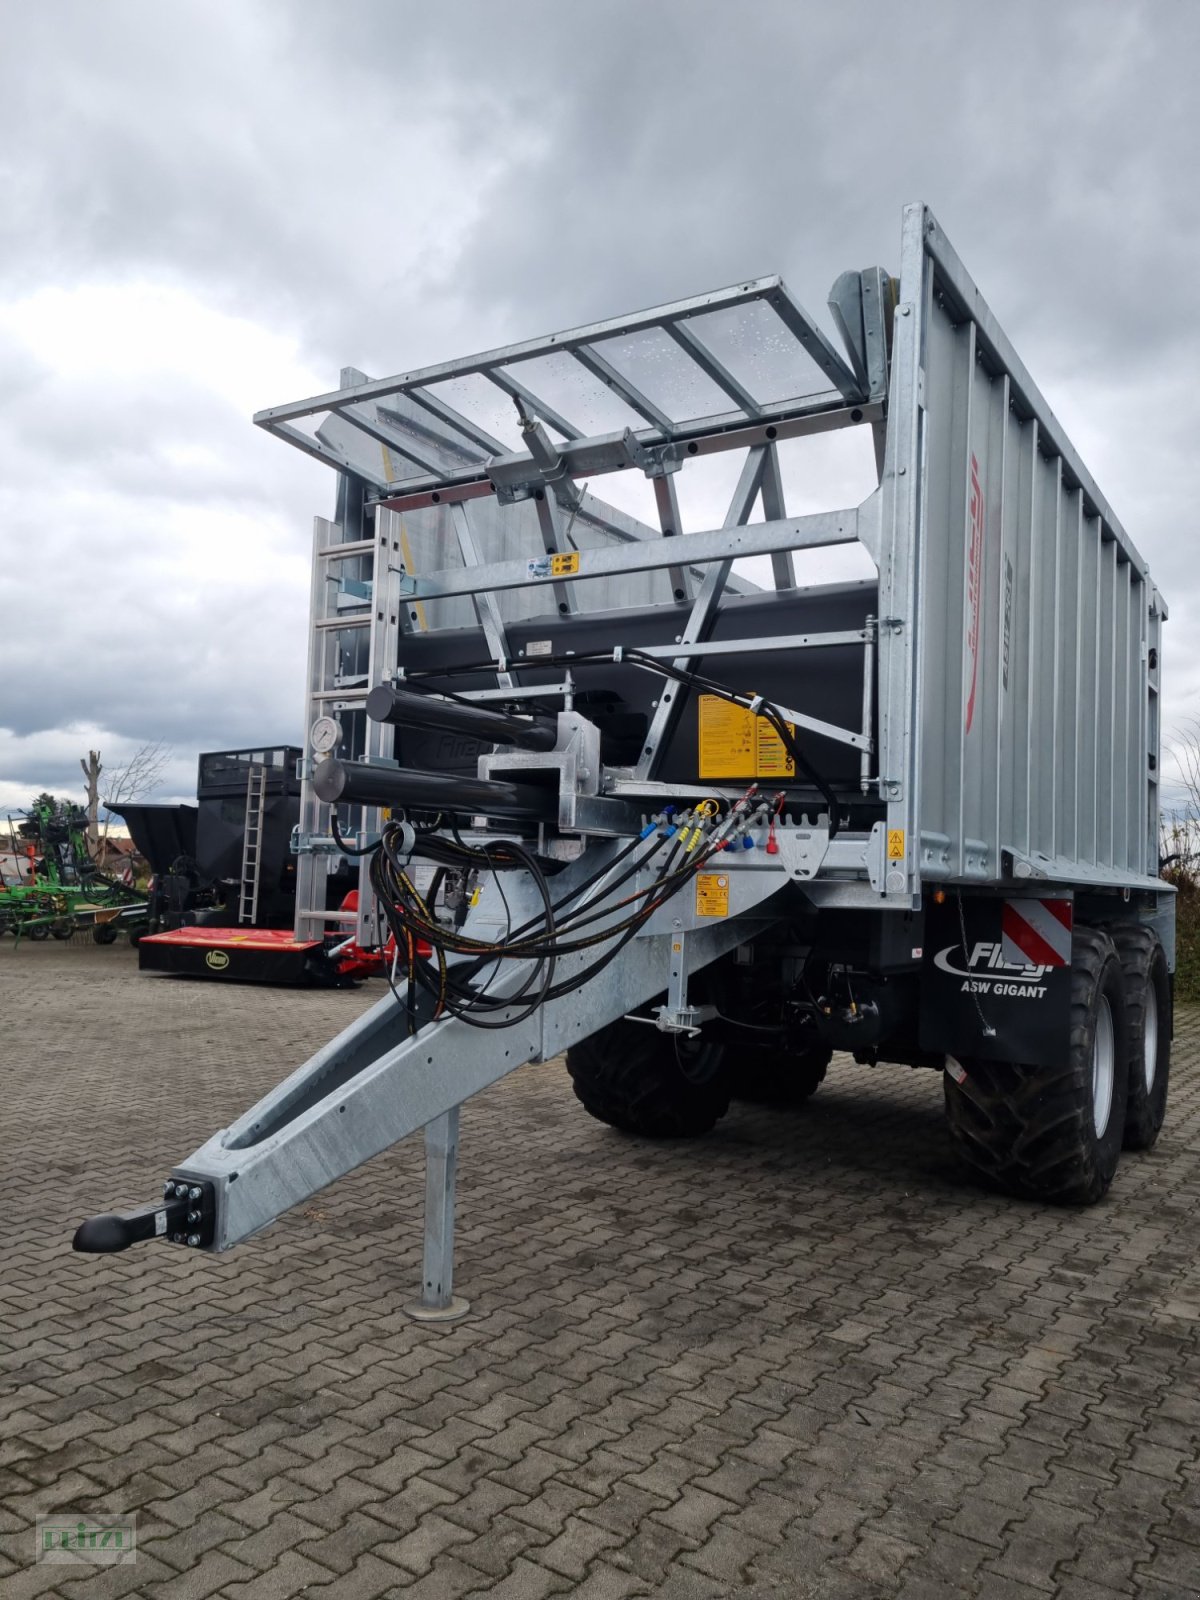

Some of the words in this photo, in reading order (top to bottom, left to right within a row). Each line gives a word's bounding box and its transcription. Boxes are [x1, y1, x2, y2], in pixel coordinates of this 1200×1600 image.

[968, 942, 1054, 977] Flig
[961, 980, 991, 994] ASW
[993, 983, 1048, 999] GIGANT
